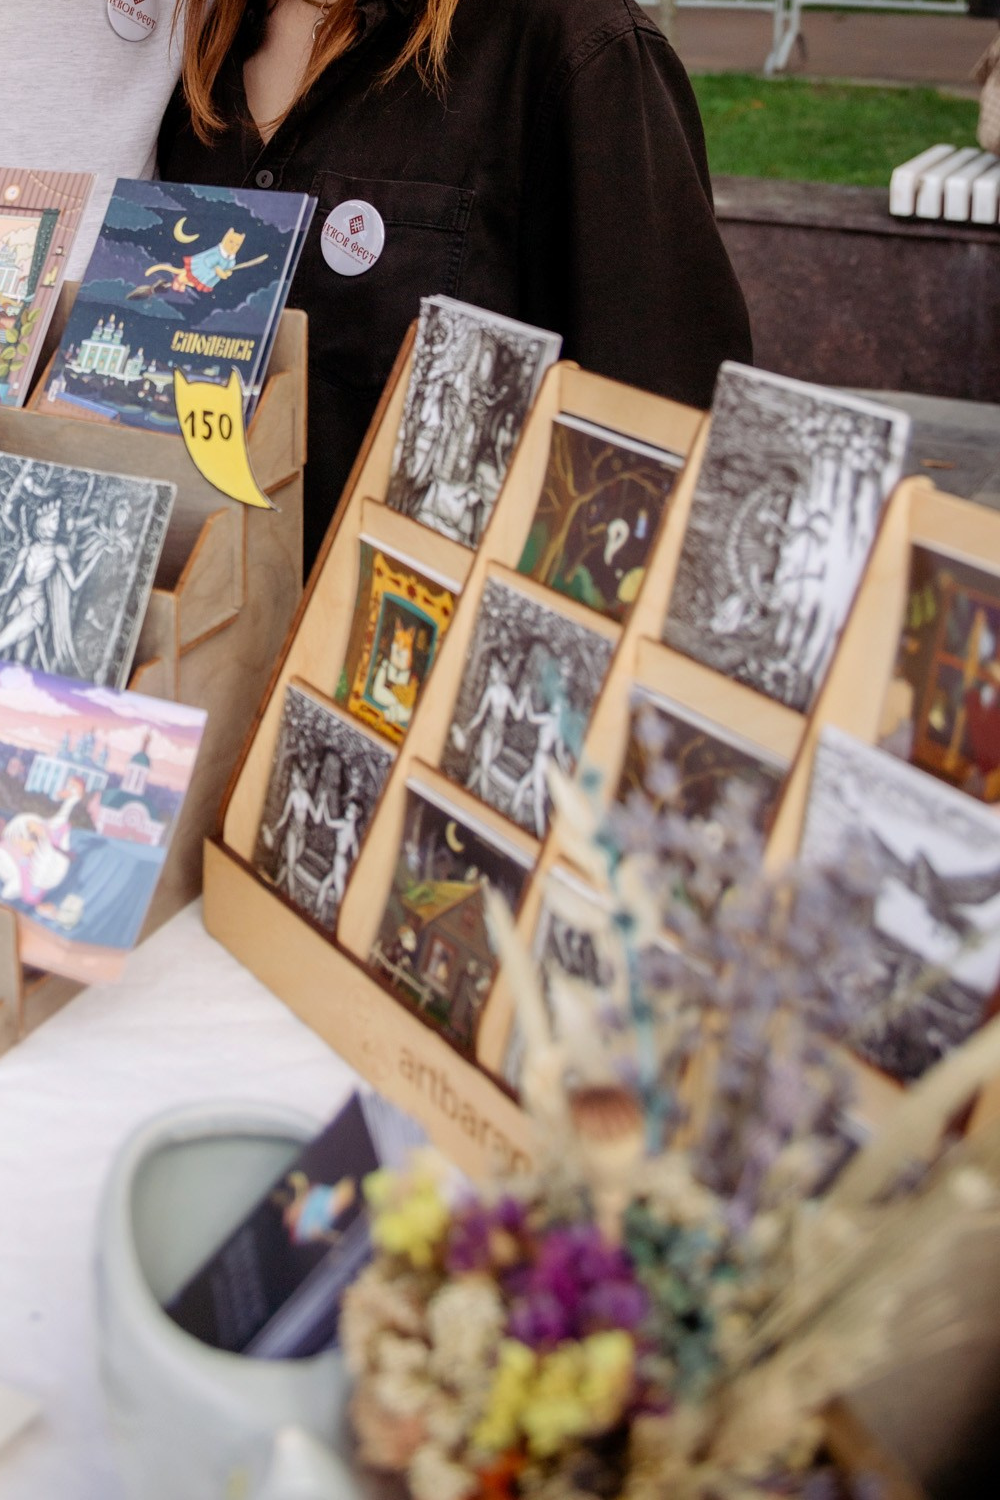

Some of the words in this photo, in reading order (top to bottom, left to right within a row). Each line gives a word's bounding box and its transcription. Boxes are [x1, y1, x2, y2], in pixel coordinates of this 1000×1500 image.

[136, 10, 157, 29] ФЕСТ
[350, 241, 377, 264] ФЕСТ
[171, 330, 255, 361] СМОЛЕНСК
[184, 411, 232, 440] 150
